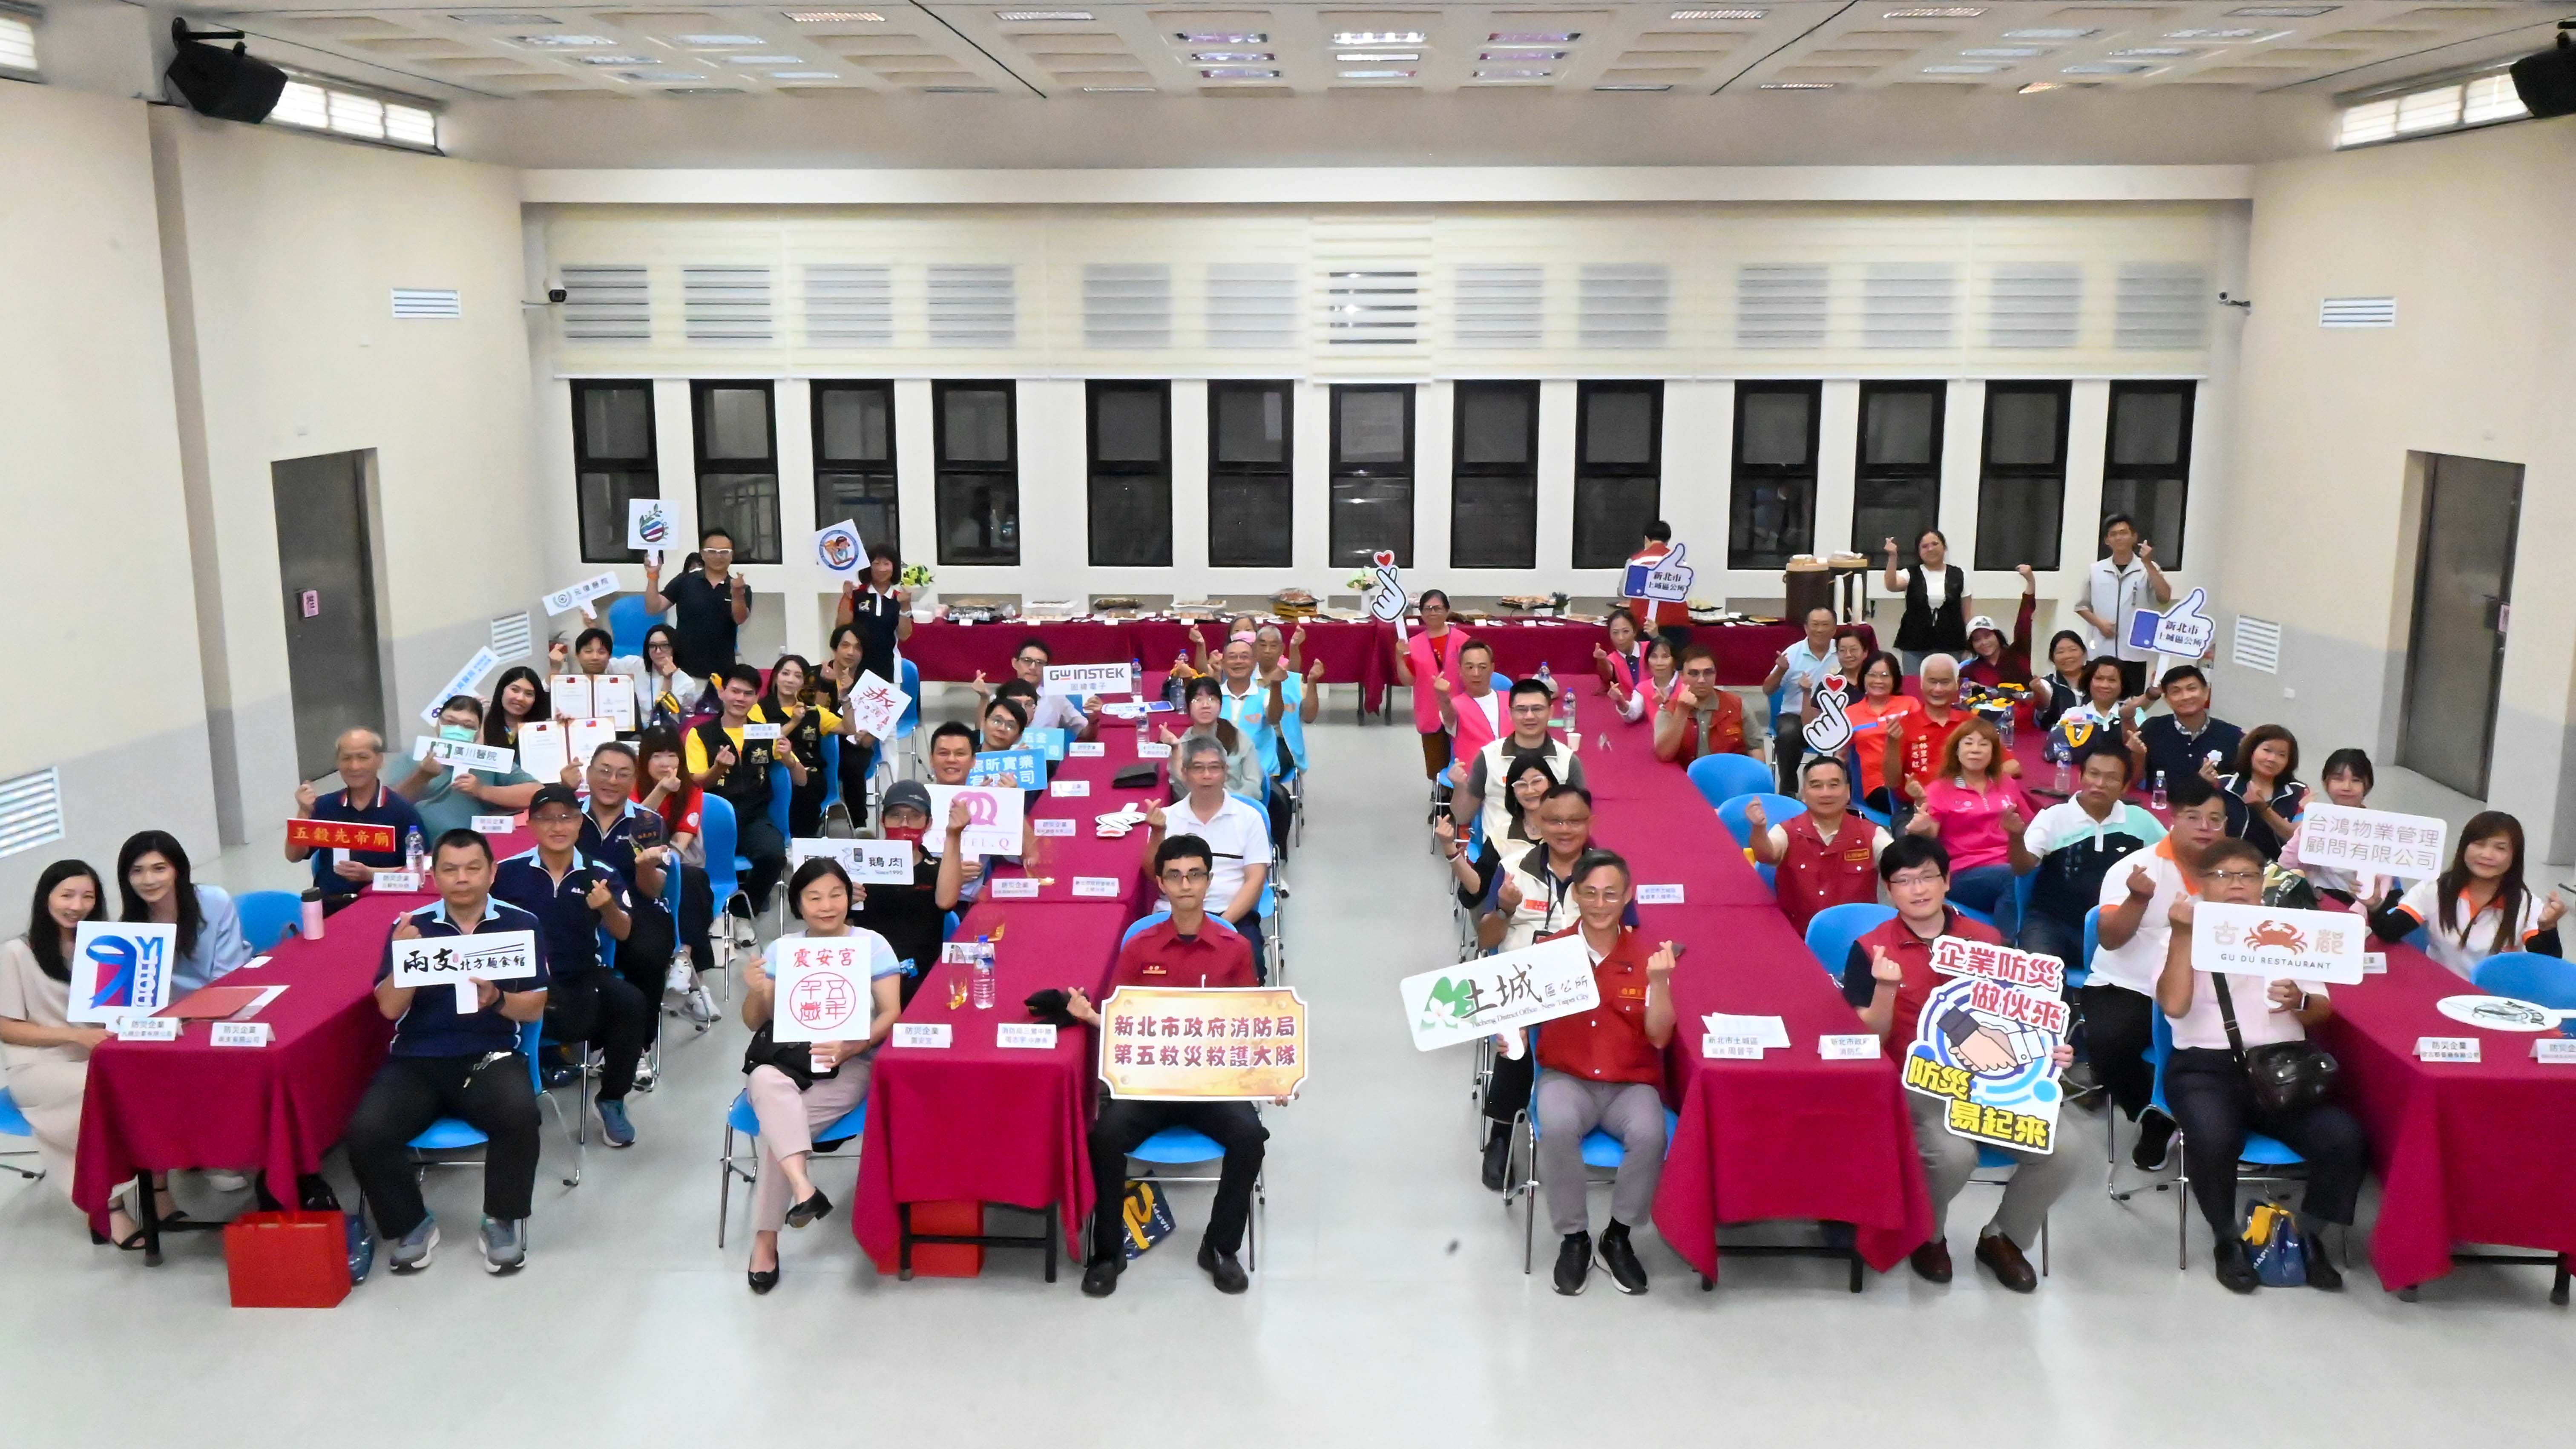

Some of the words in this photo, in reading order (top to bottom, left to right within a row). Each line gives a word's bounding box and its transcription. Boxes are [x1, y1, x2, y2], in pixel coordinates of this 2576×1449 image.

[1653, 571, 1682, 582] 新北市
[2165, 620, 2199, 635] 新北市
[969, 770, 1034, 787] 有限司
[293, 826, 389, 847] 五穀先帝廟
[2309, 814, 2439, 848] 台鴻物業管理
[869, 857, 903, 868] 鵝肉
[2305, 836, 2436, 871] 顧問有限公司
[403, 948, 458, 973] 兩支
[793, 948, 856, 968] 震安宮
[1937, 940, 2058, 987] 企業防災
[2220, 953, 2235, 961] GU
[2260, 957, 2332, 970] RESTAURANT
[1460, 963, 1543, 1019] 土城
[1544, 975, 1588, 998] 區公所
[1971, 981, 2062, 1030] 做伙來
[905, 1026, 939, 1035] 防災企業
[1114, 1014, 1295, 1038] 新北市政府消防局
[1708, 1036, 1759, 1045] 新北市土城區
[2432, 1041, 2467, 1050] 防災企業
[1114, 1044, 1295, 1067] 第五救災救護大隊
[1907, 1055, 1972, 1100] 防災
[1949, 1099, 2047, 1147] 易起來
